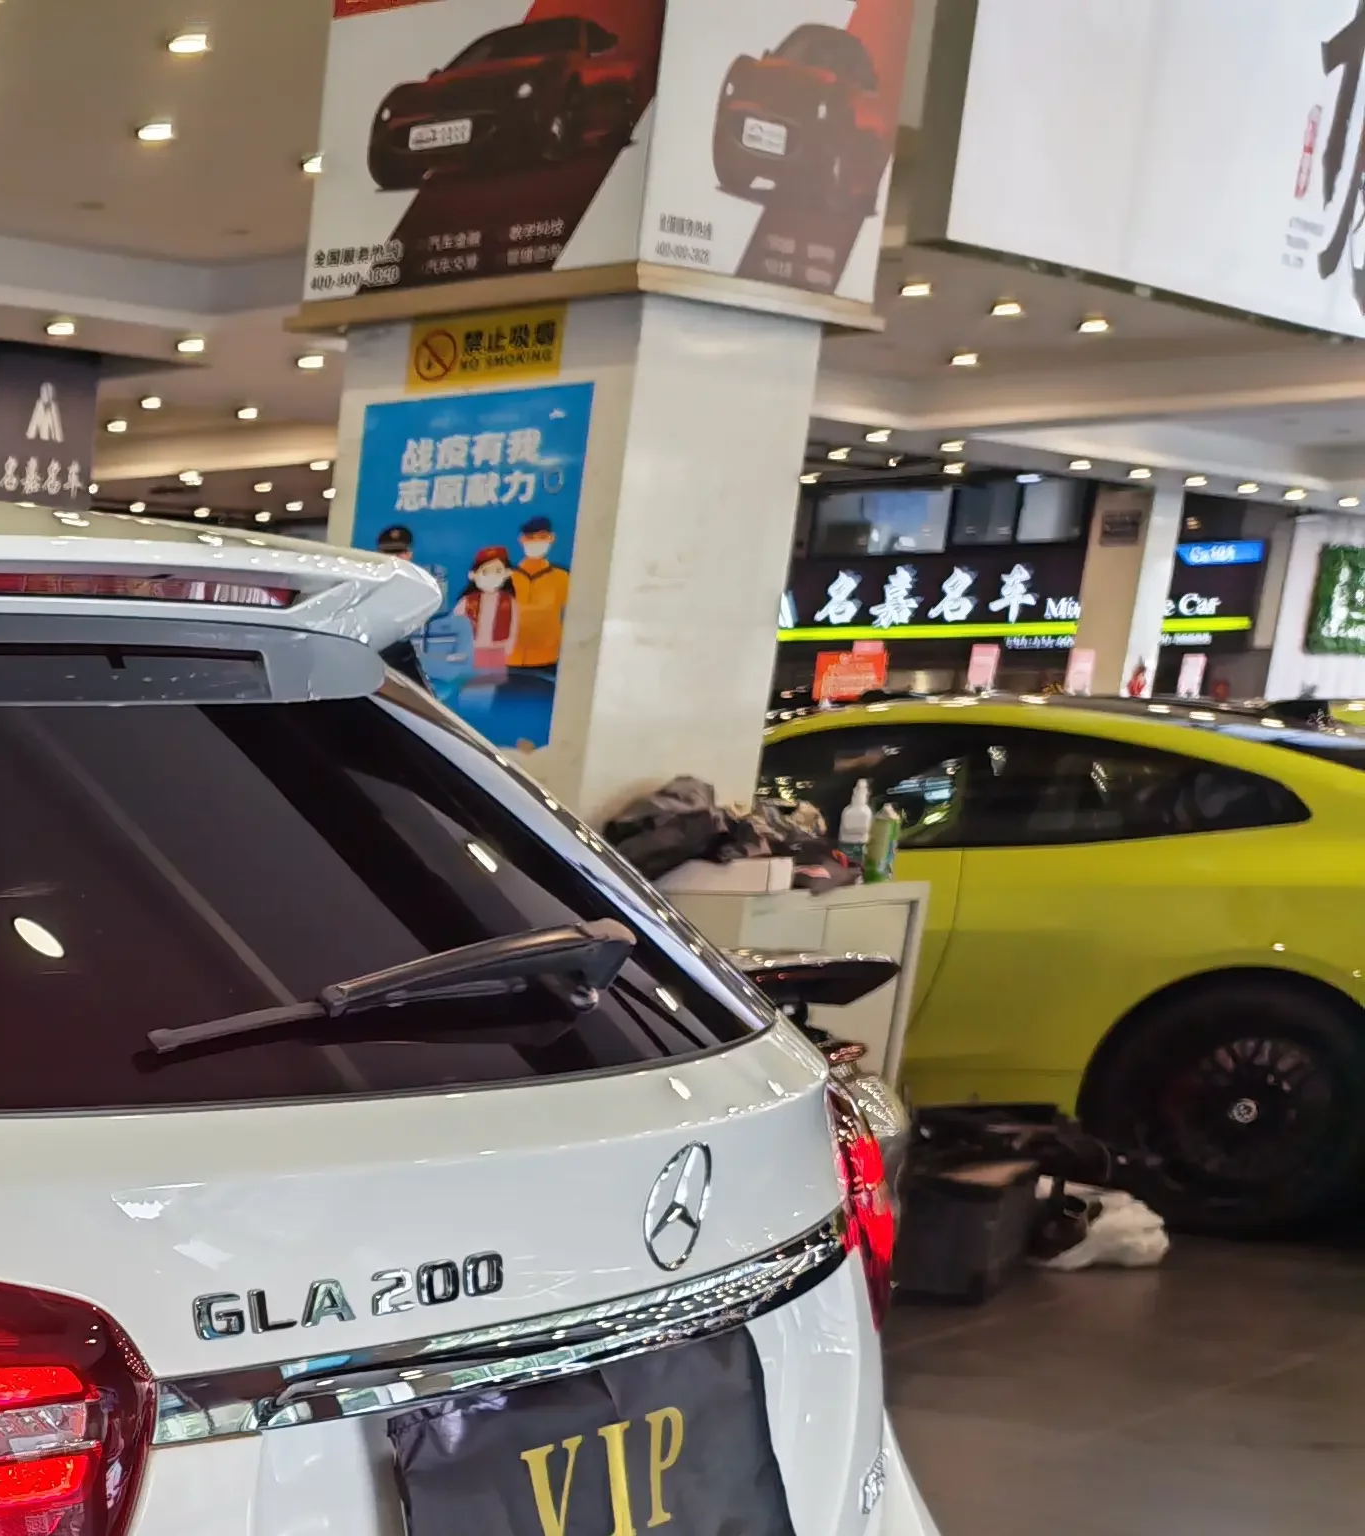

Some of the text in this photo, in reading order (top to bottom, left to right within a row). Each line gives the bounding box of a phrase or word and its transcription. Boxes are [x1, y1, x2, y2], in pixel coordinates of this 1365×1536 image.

[814, 563, 1037, 629] 名嘉名车
[1178, 593, 1221, 616] Car
[192, 1250, 504, 1341] GLA 200
